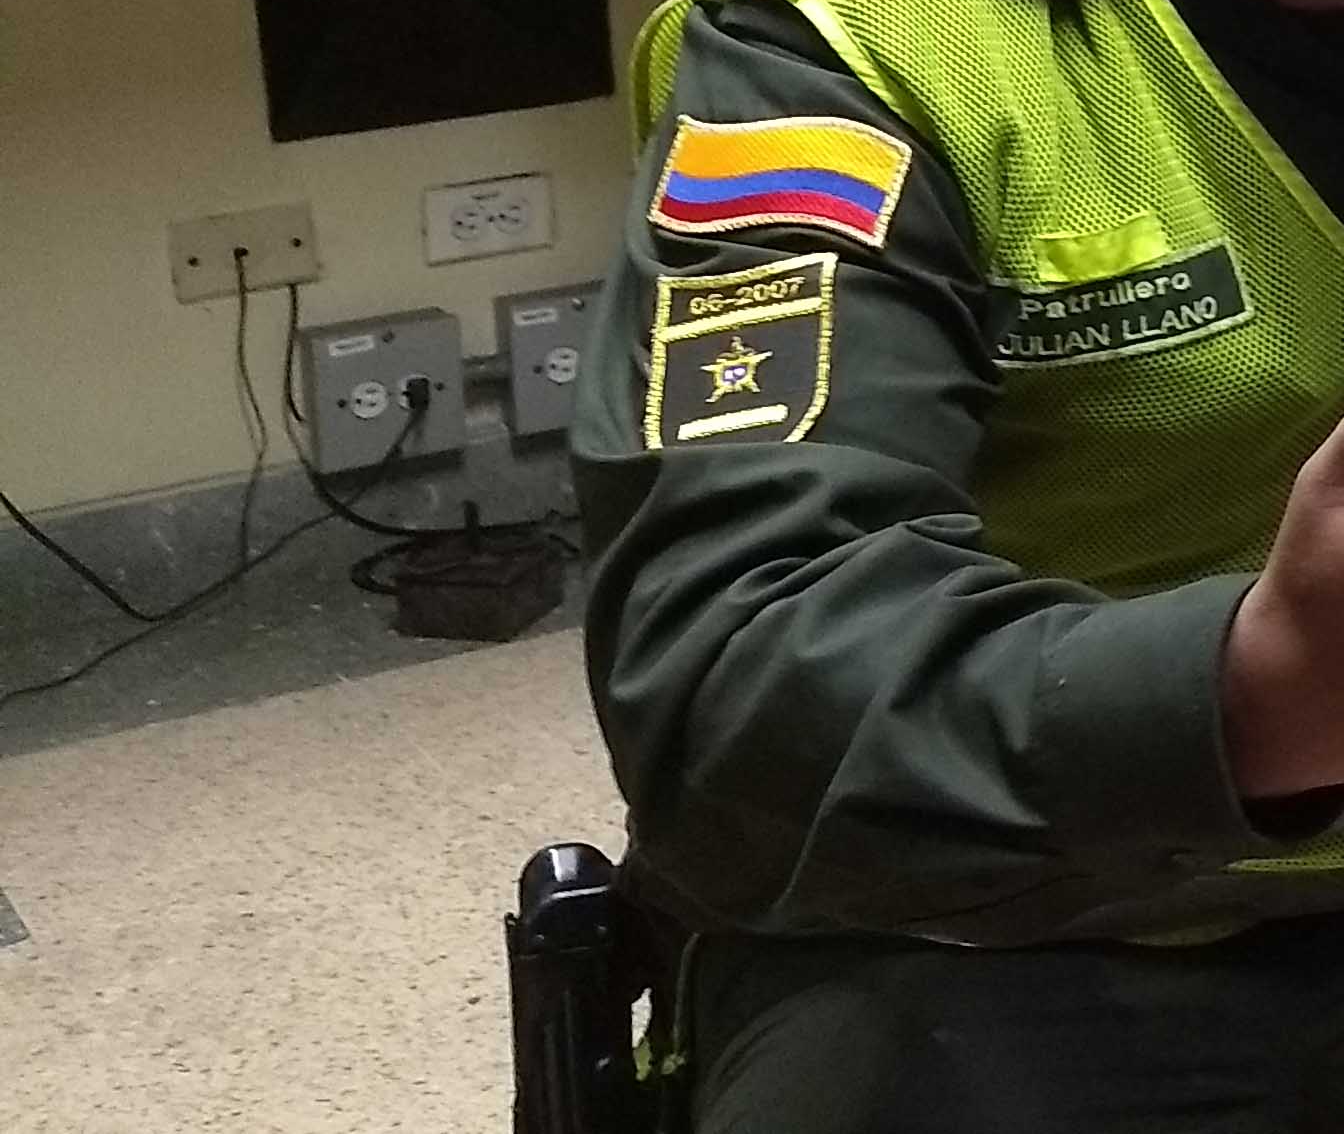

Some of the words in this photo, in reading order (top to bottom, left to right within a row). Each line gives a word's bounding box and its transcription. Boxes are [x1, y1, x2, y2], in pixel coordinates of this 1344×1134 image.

[1017, 272, 1191, 320] Patrullero
[996, 322, 1111, 355] JULIAN
[1121, 295, 1218, 340] LLANO
